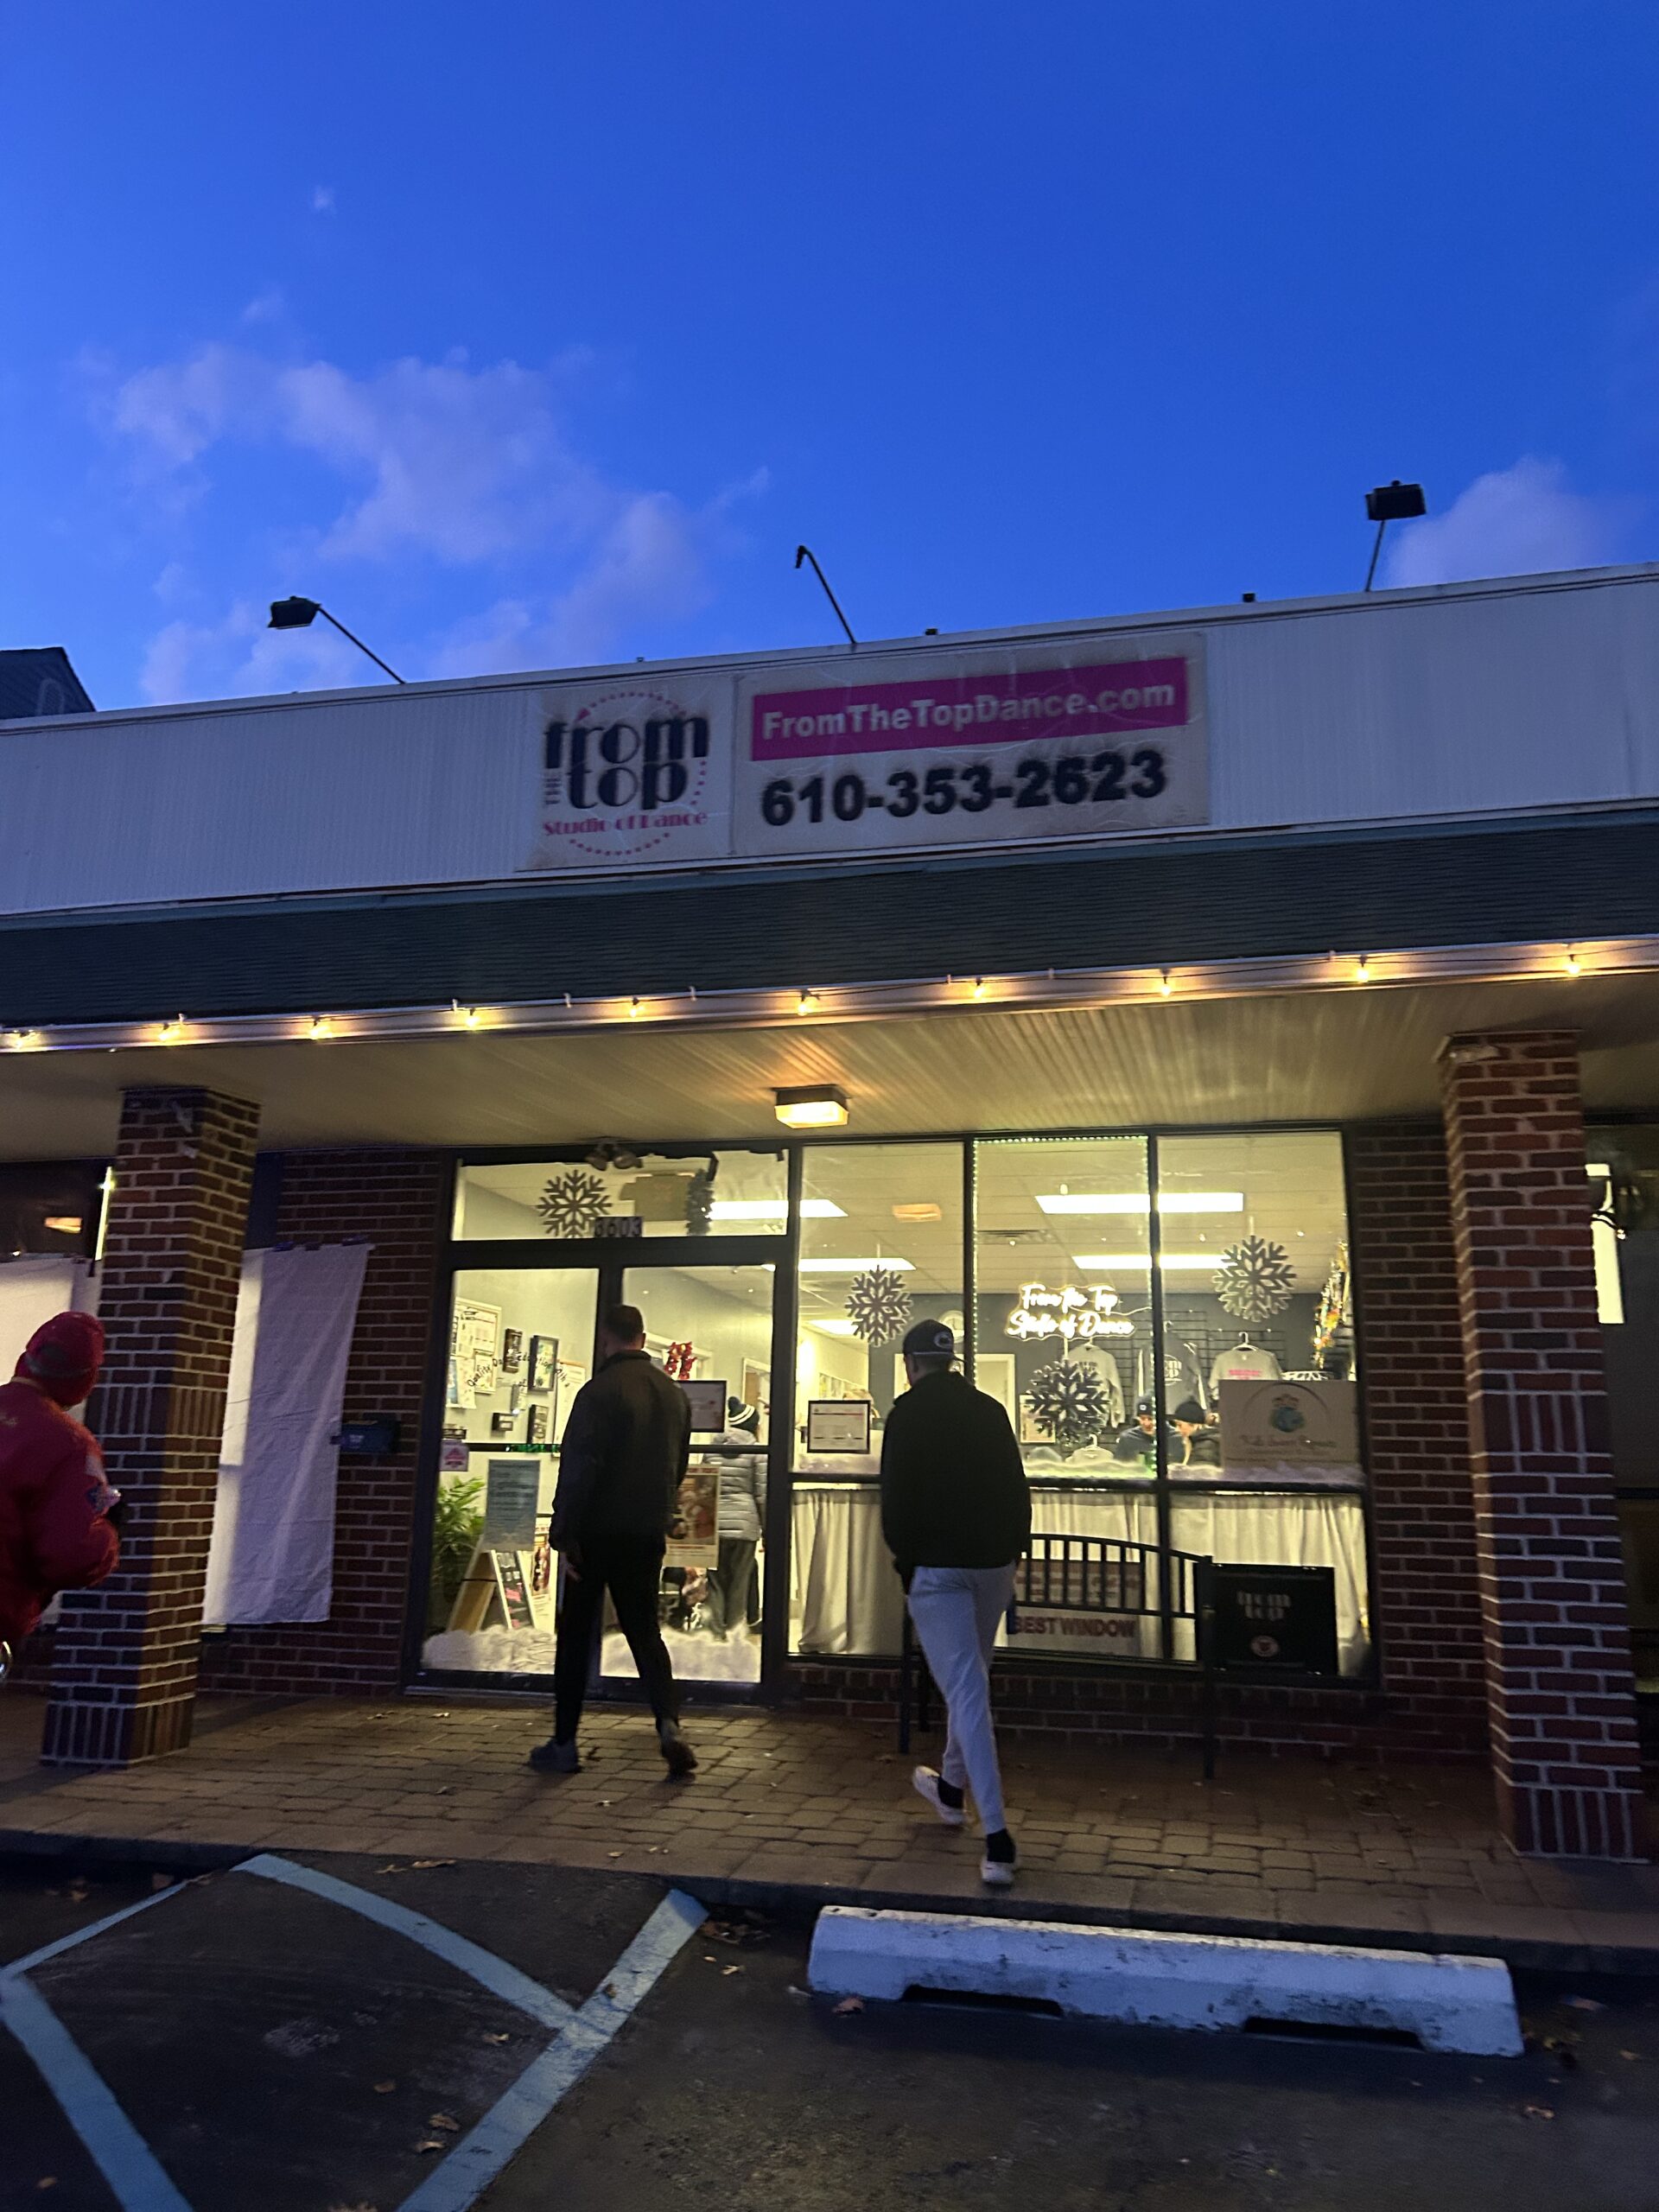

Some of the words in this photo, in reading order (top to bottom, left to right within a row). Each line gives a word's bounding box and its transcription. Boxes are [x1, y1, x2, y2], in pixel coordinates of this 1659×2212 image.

[762, 684, 1175, 741] FromTheTopDance.com
[543, 716, 709, 769] from
[566, 761, 689, 810] top
[762, 749, 1166, 827] 610-353-2623
[1058, 1617, 1137, 1639] WINDOW
